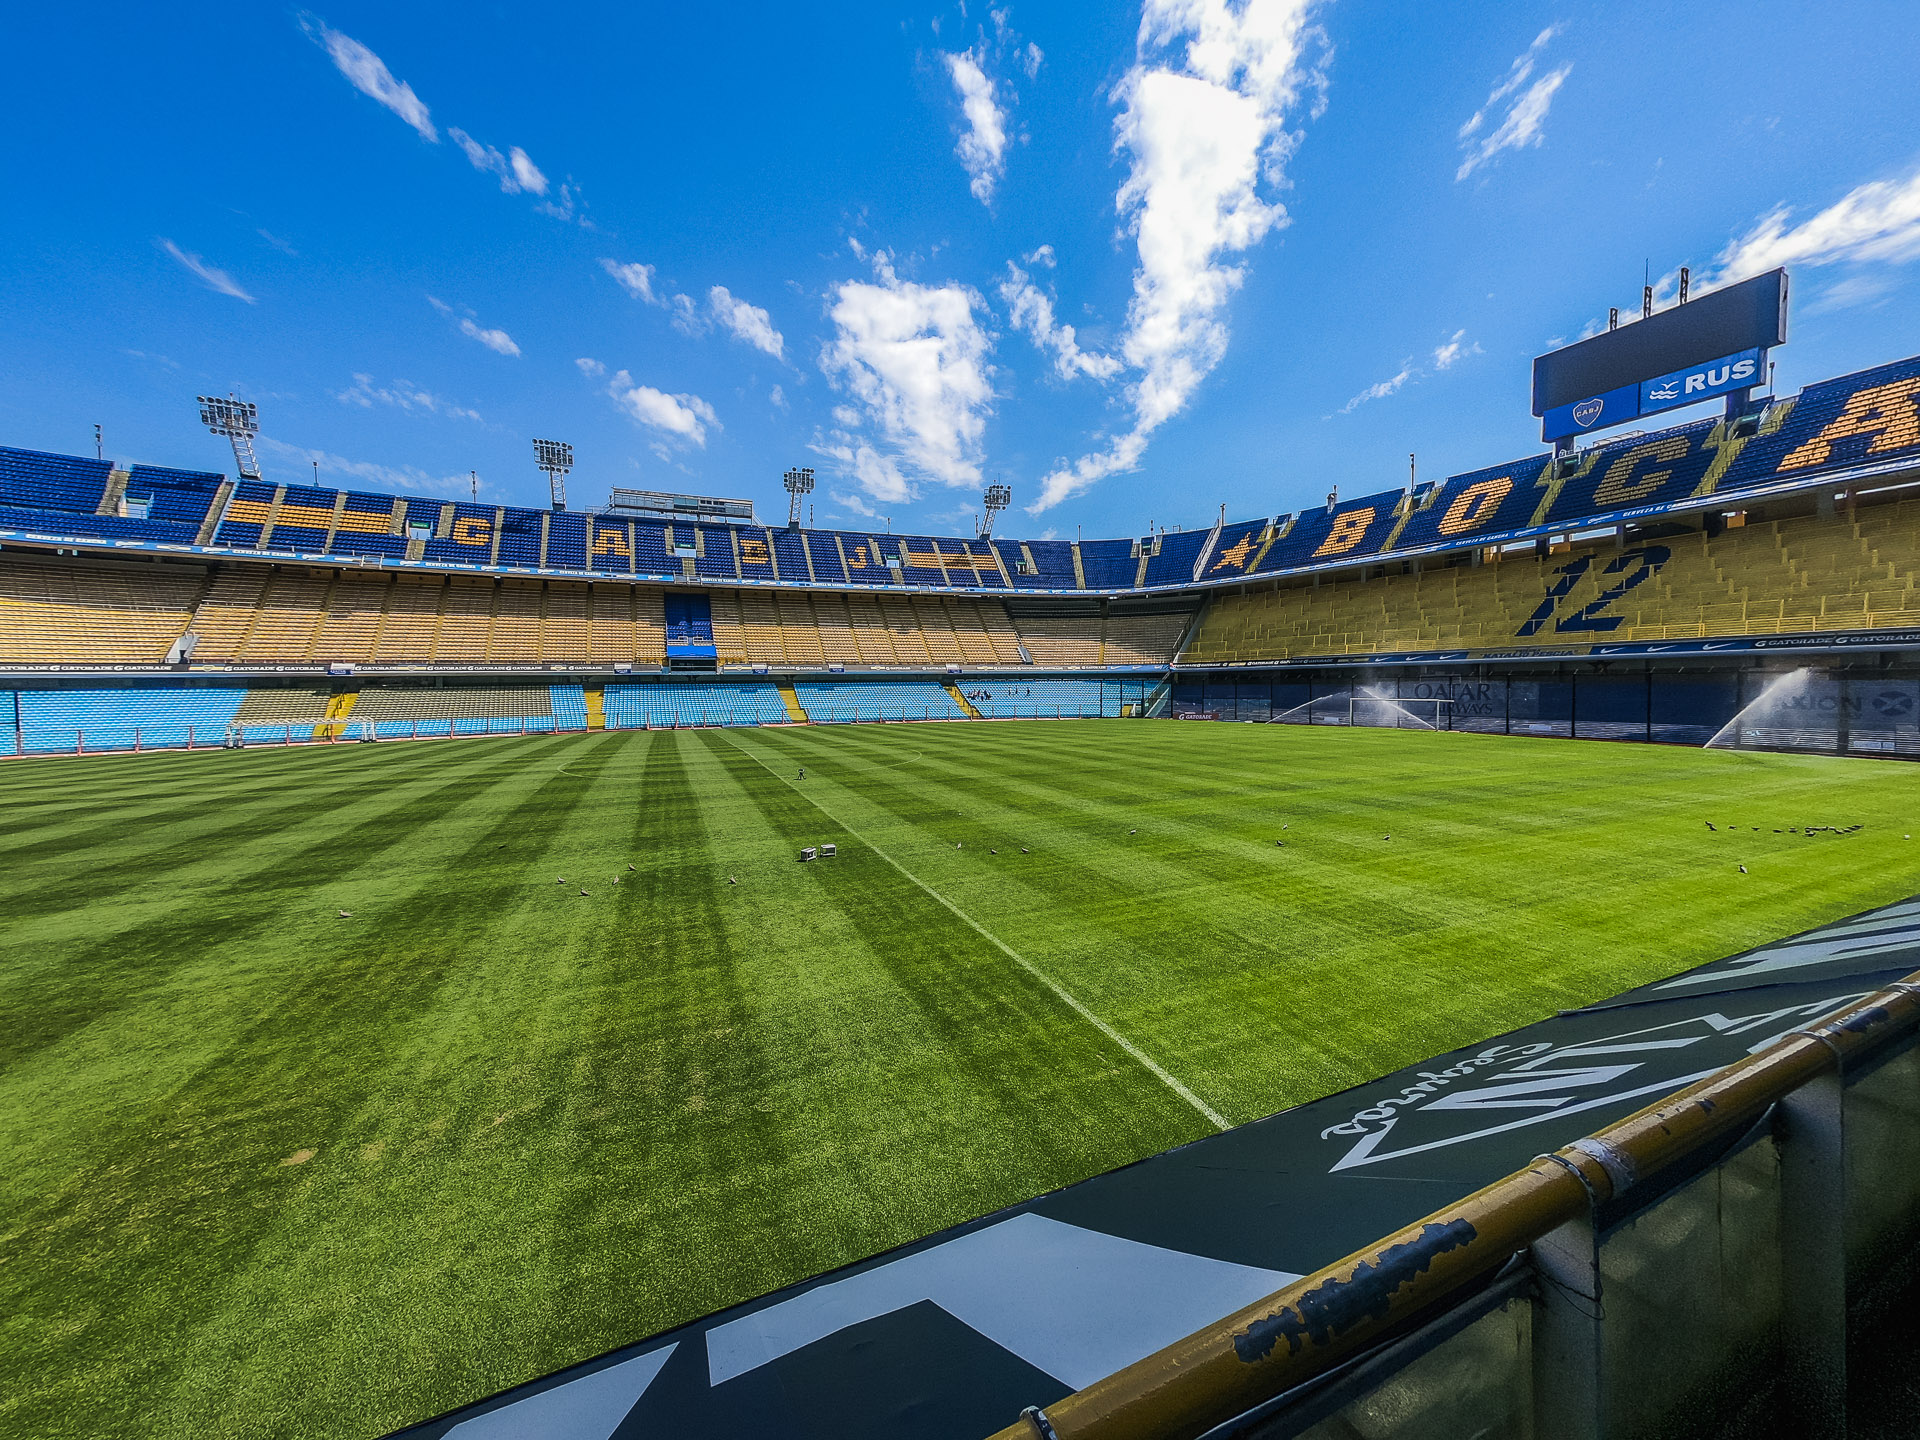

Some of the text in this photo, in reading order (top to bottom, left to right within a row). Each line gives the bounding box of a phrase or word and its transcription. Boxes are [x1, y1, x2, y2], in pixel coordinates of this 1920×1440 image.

[1685, 359, 1755, 394] RUS
[1515, 545, 1671, 636] 12
[1769, 637, 1834, 646] GATORADE
[1414, 683, 1491, 700] QATAR
[1432, 703, 1493, 715] AIRWAYS
[1320, 1042, 1553, 1140] Seguros
